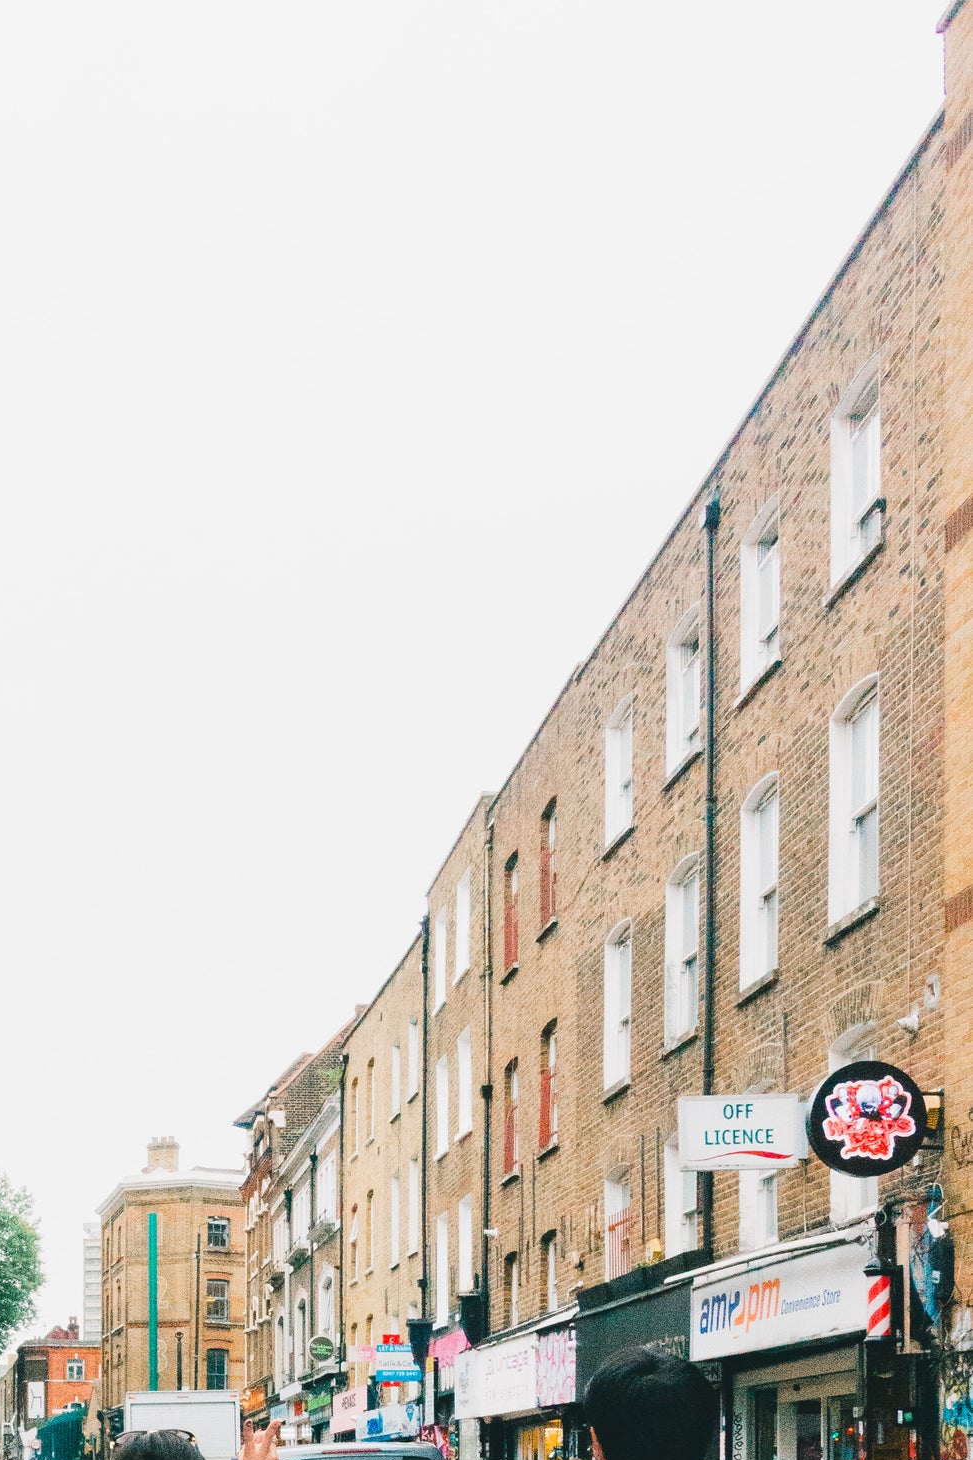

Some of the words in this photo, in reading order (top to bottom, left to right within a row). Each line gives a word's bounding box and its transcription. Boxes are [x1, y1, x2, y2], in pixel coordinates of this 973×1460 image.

[722, 1103, 754, 1119] OFF
[704, 1128, 775, 1146] LICENCE
[781, 1295, 821, 1315] Convenience
[822, 1289, 842, 1306] Store
